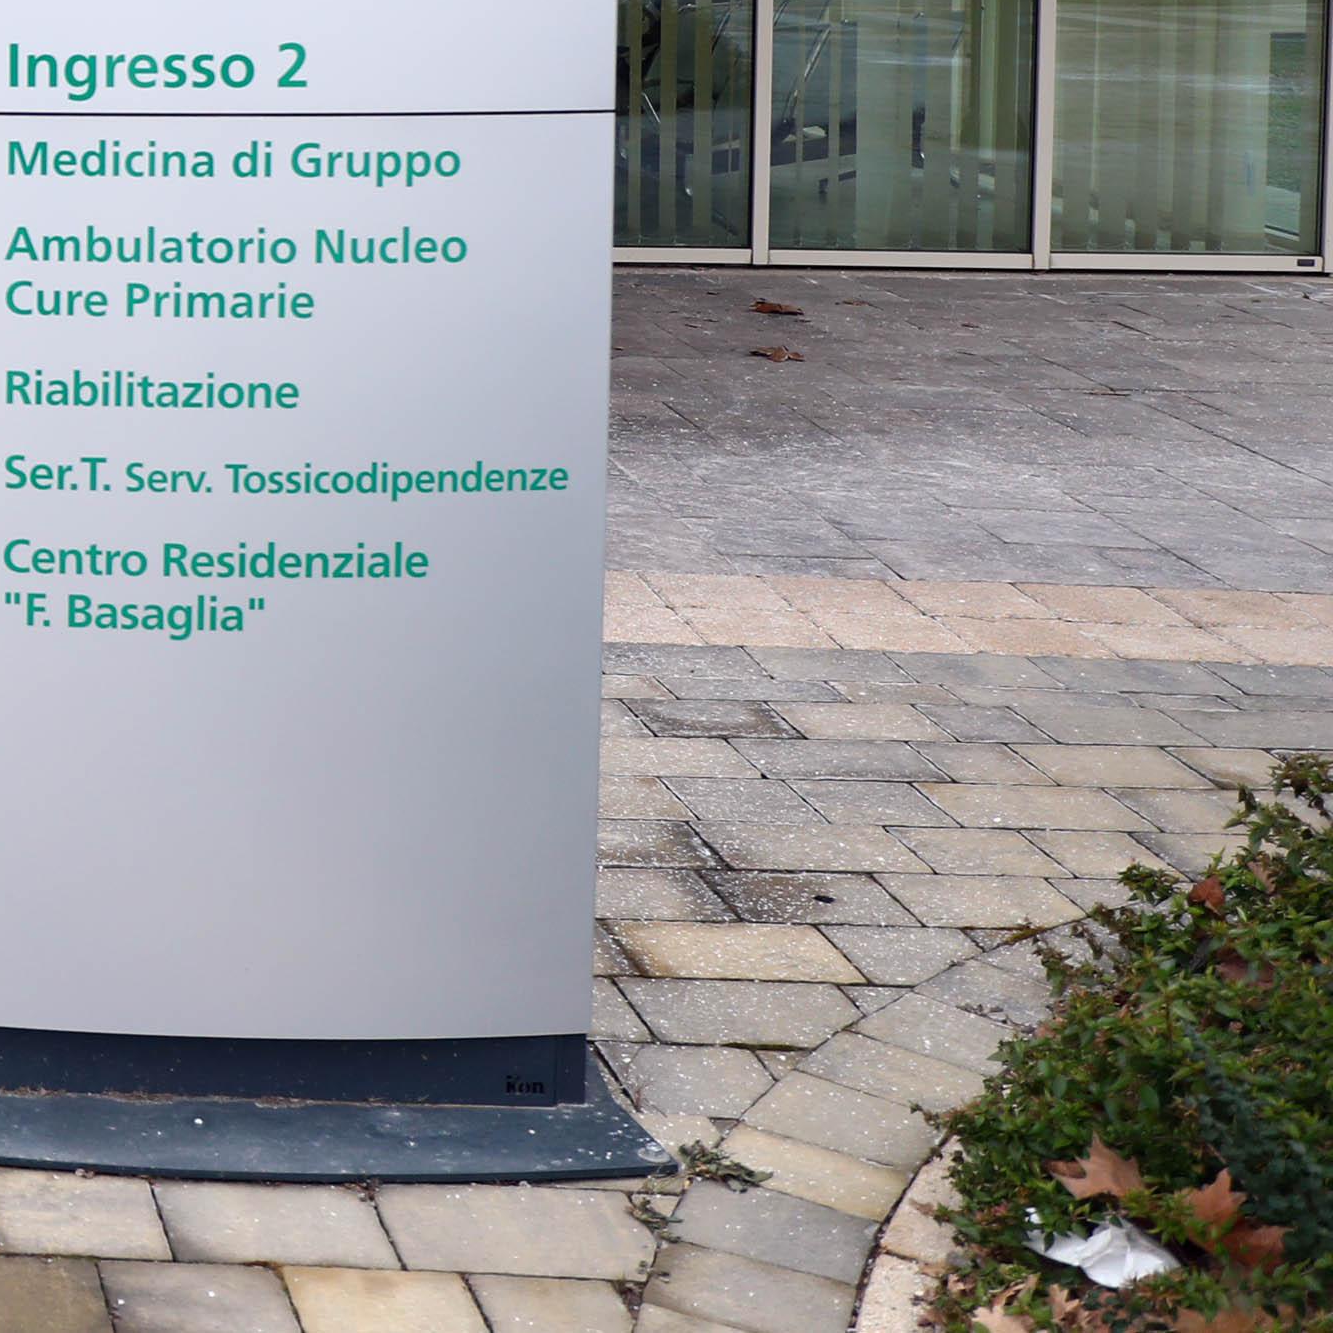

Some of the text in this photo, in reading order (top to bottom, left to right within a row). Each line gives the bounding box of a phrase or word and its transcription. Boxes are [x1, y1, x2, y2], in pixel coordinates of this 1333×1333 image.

[7, 42, 309, 101] Ingresso 2
[6, 140, 461, 188] Medicina di Gruppo
[5, 227, 468, 265] Ambulatorio Nucleo
[4, 281, 315, 320] Cure Primarie
[4, 370, 300, 409] Riabilitazione
[4, 456, 569, 502] Ser.T. Serv. Tossicodipendenze
[3, 539, 430, 579] Centro Residenziale
[4, 593, 266, 640] "F. Basaglia"
